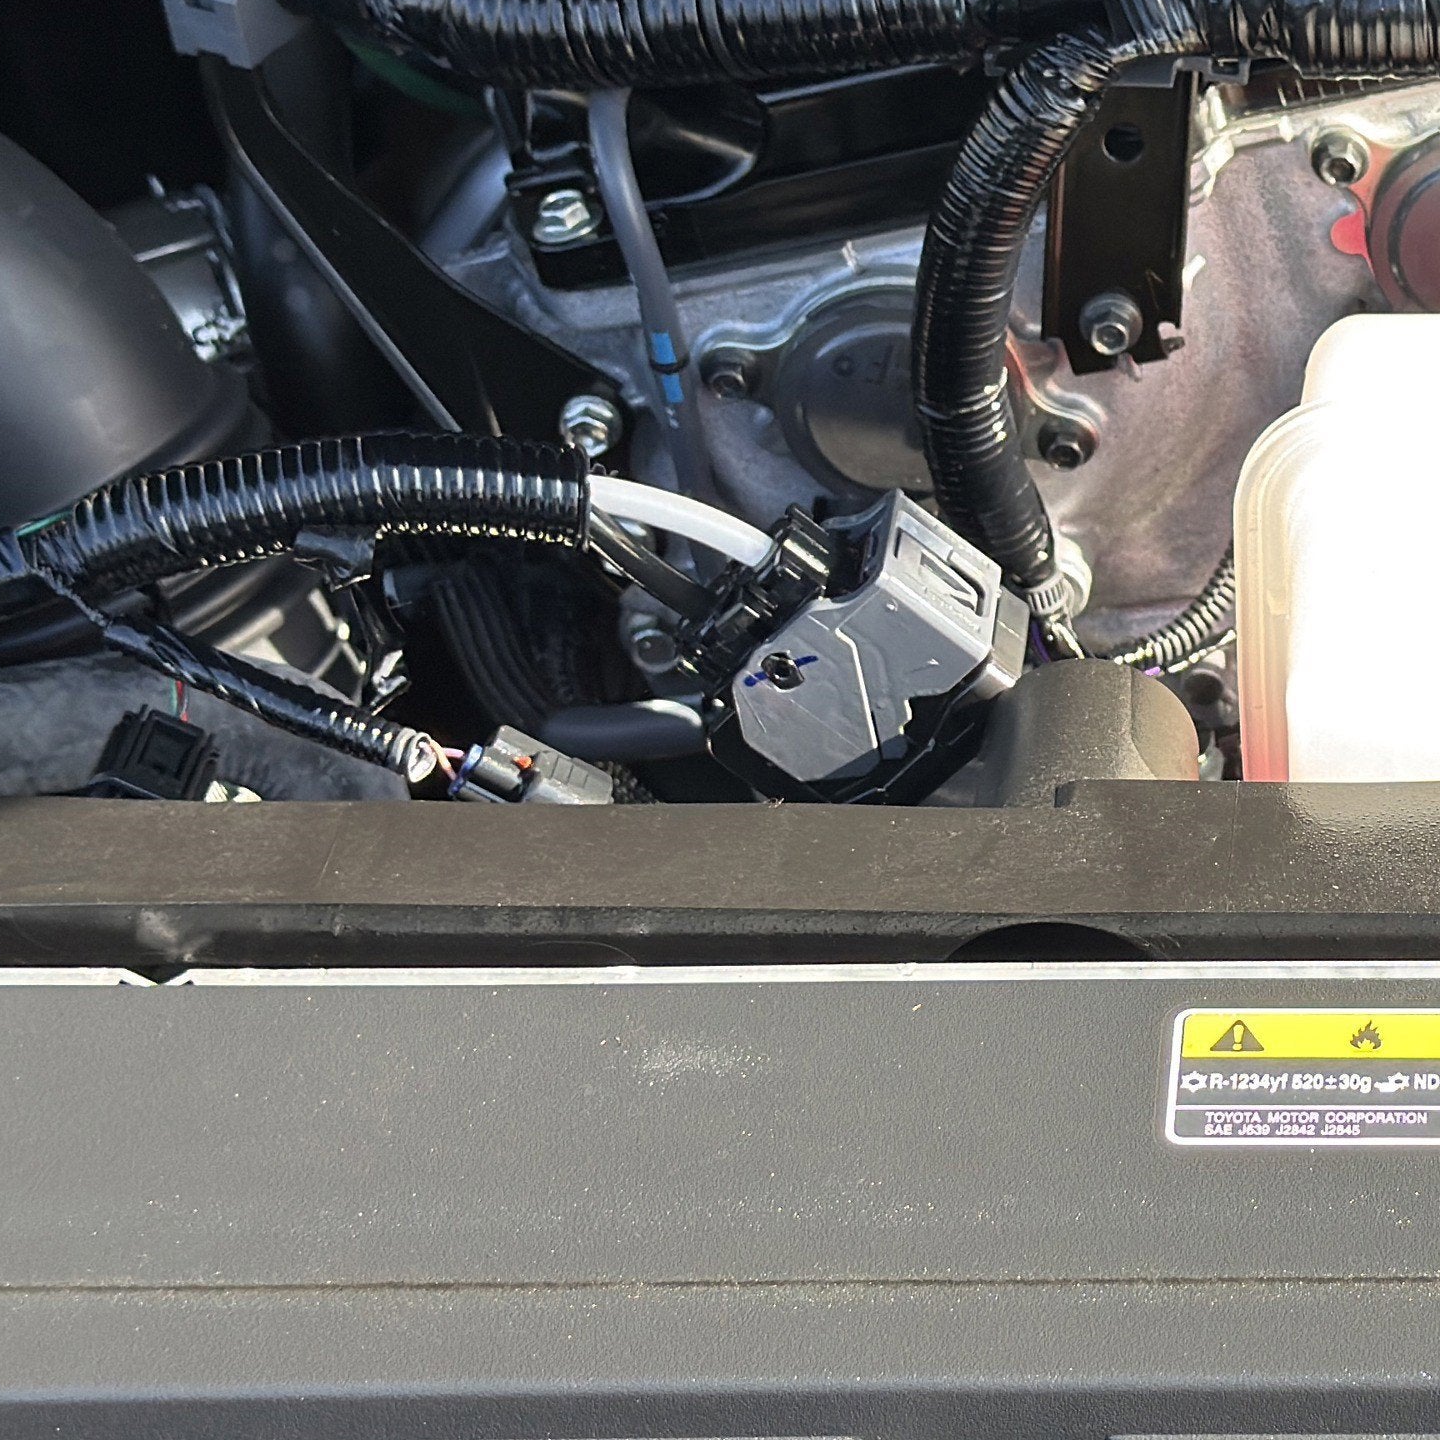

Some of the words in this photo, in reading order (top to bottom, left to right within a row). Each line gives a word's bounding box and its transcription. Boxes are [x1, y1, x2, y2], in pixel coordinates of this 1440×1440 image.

[1209, 1072, 1289, 1093] R-1234yf
[1291, 1073, 1372, 1093] 520±30g
[1204, 1111, 1262, 1124] TOYOTA
[1267, 1111, 1319, 1124] MOTOR
[1324, 1111, 1428, 1124] CORPORATION
[1204, 1124, 1233, 1136] SAE
